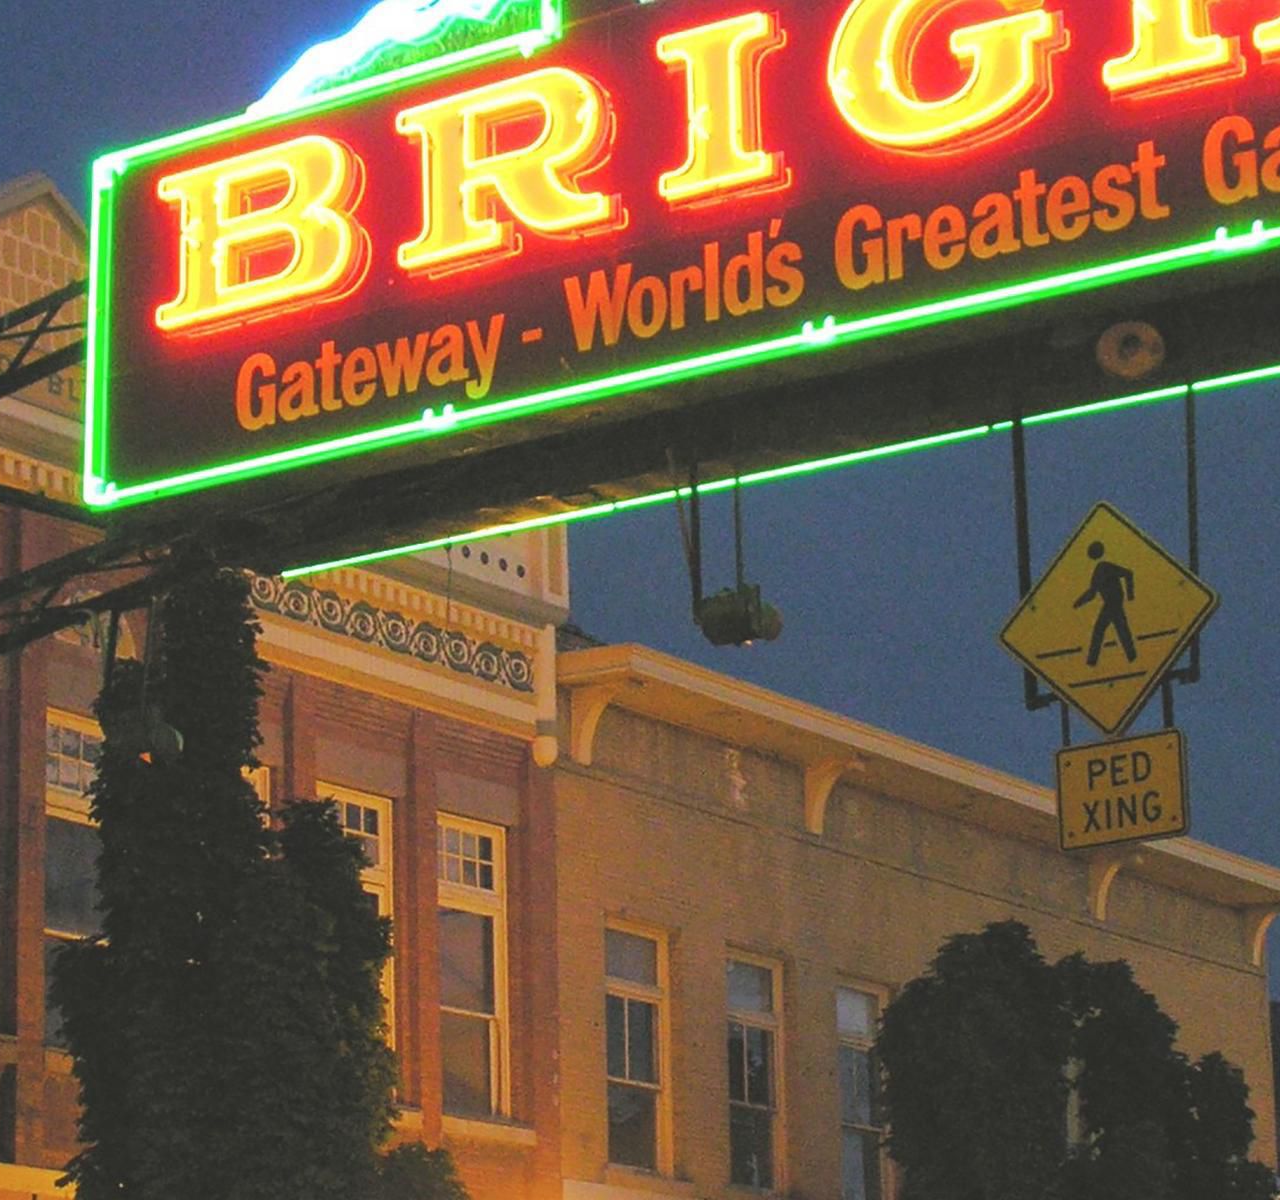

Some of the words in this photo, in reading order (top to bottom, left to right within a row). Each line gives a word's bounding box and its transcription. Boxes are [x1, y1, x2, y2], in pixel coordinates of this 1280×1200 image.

[234, 312, 505, 432] Gateway
[563, 218, 805, 353] World's
[834, 140, 1170, 291] Greatest
[1087, 751, 1152, 791] PED
[1081, 790, 1163, 834] XING
